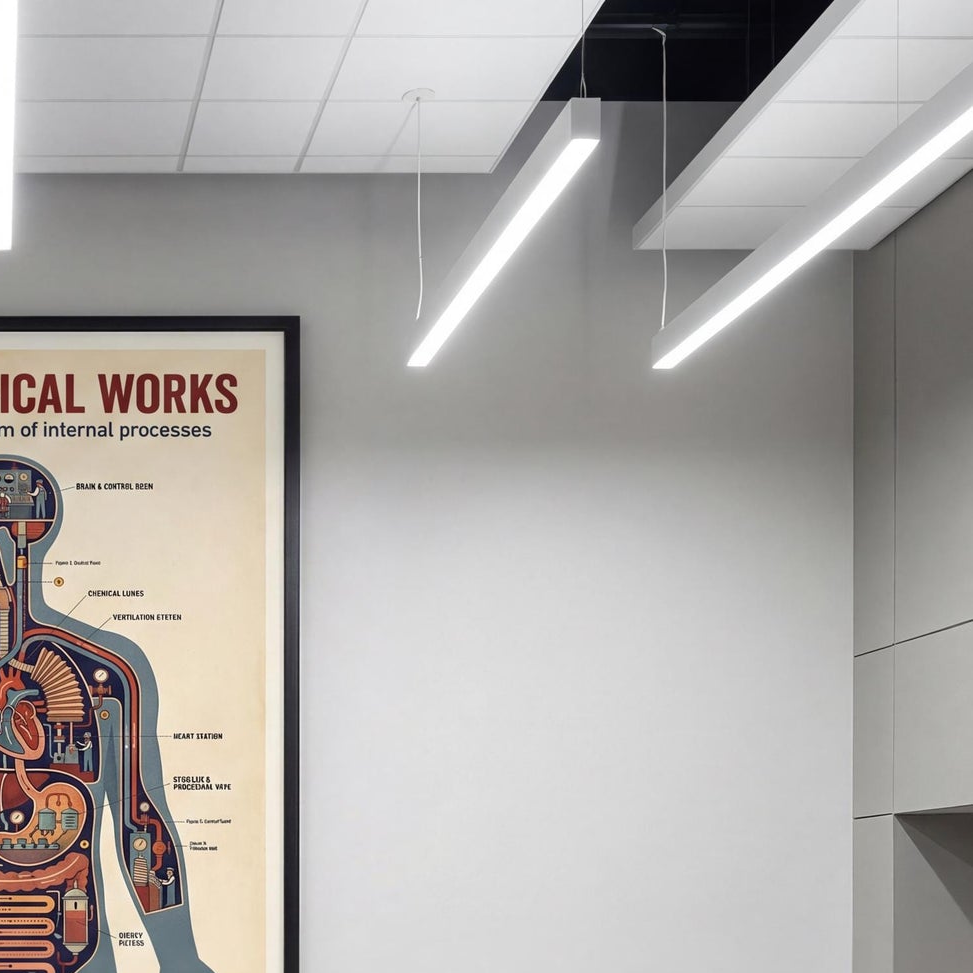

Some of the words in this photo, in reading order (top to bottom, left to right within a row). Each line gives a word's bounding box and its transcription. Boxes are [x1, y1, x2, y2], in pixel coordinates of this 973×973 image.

[97, 373, 238, 414] WORKS
[20, 421, 39, 438] of
[43, 421, 114, 438] internal
[120, 424, 212, 441] processes
